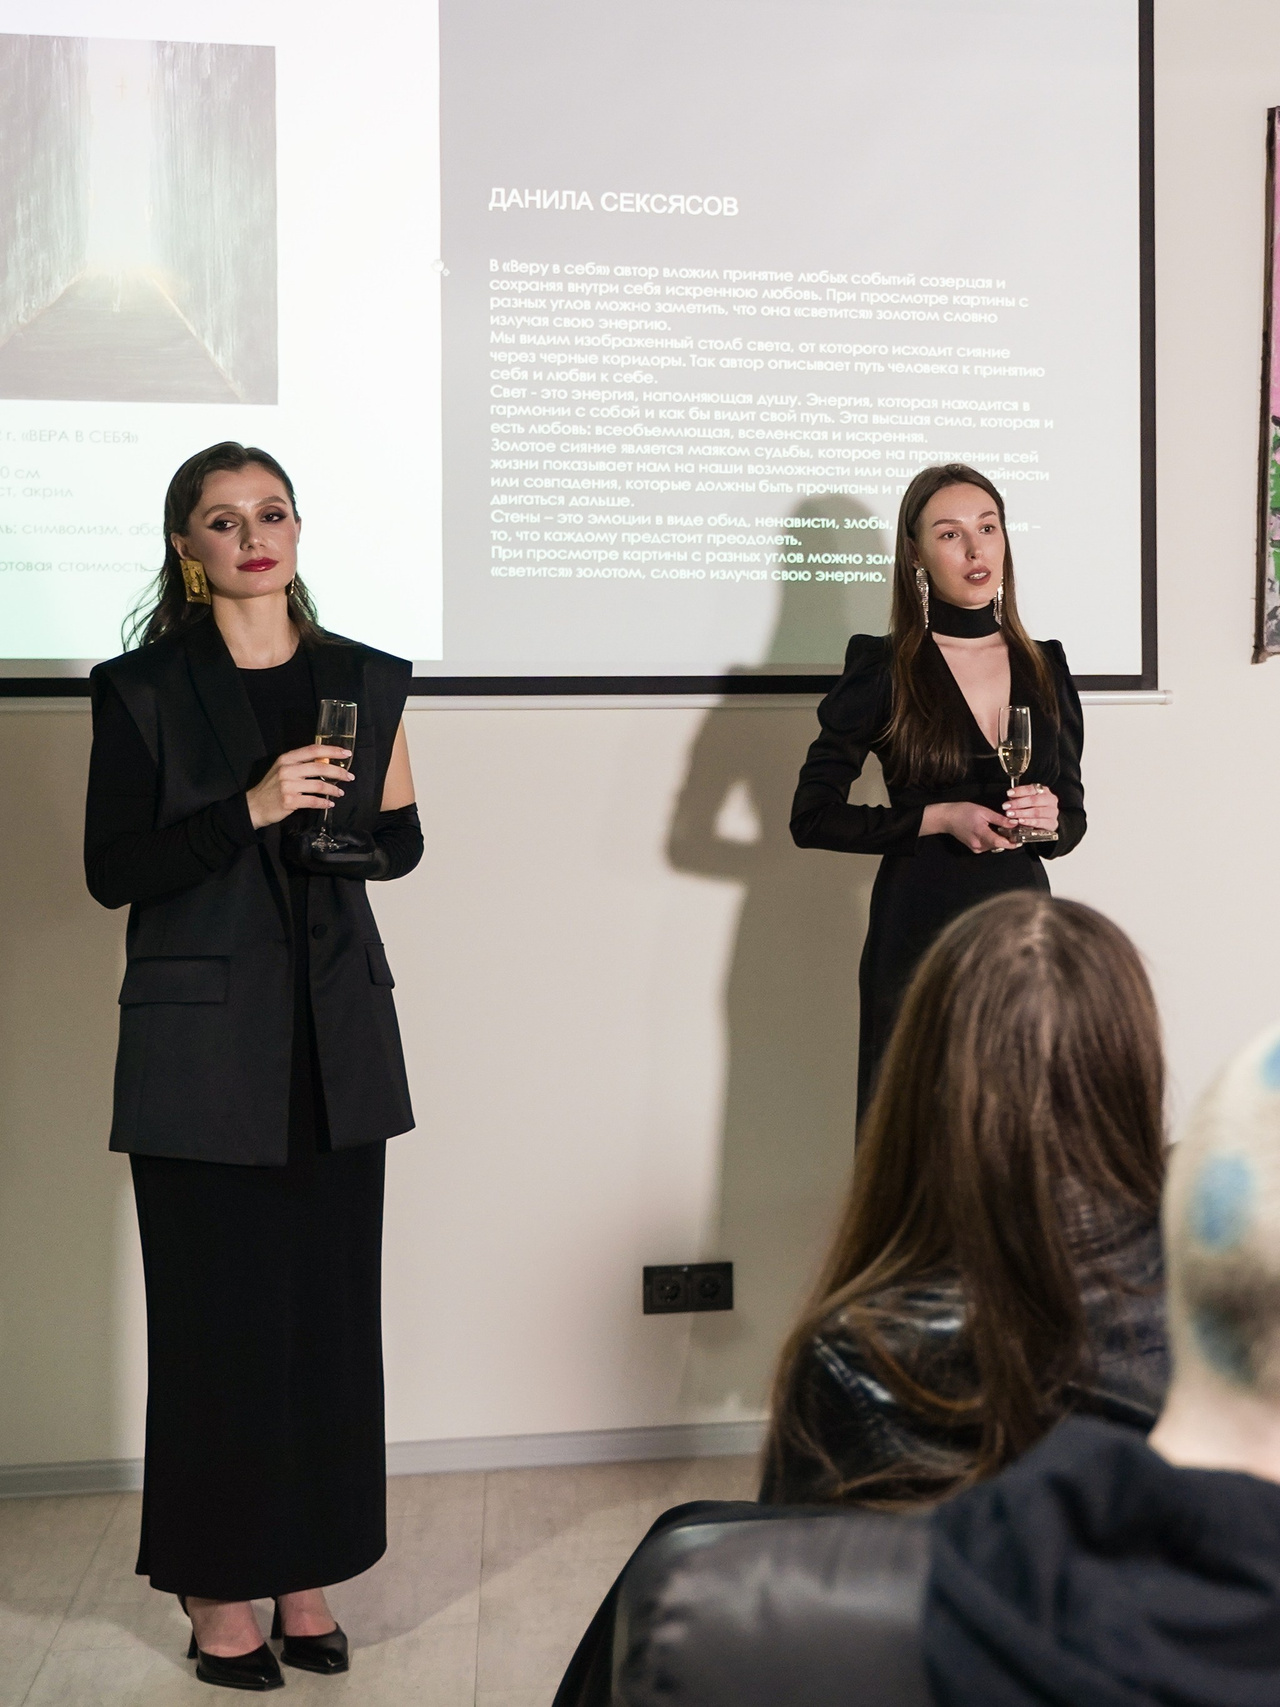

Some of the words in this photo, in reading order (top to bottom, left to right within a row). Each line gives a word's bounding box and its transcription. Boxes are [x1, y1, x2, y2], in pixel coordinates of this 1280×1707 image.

[488, 187, 594, 212] ДАНИЛА
[600, 191, 739, 216] СЕКСЯСОВ
[489, 258, 499, 272] В
[501, 259, 550, 277] «Веру
[552, 263, 561, 274] в
[563, 261, 610, 276] себя»
[613, 265, 659, 280] автор
[662, 267, 720, 279] вложил
[722, 269, 794, 283] принятие
[797, 269, 848, 284] любых
[850, 271, 916, 286] событий
[919, 276, 993, 291] созерцая
[995, 278, 1006, 289] и
[488, 279, 563, 294] сохраняя
[567, 281, 619, 296] внутри
[622, 281, 661, 295] себя
[665, 285, 758, 299] искреннюю
[761, 286, 822, 301] любовь.
[826, 287, 856, 304] При
[860, 291, 949, 307] просмотре
[952, 294, 1016, 308] картины
[1018, 296, 1029, 308] с
[489, 296, 547, 310] разных
[549, 298, 591, 312] углов
[594, 300, 651, 313] можно
[654, 301, 729, 316] заметить,
[732, 304, 757, 316] что
[760, 305, 791, 317] она
[793, 306, 873, 319] «светится»
[875, 309, 940, 321] золотом
[942, 311, 998, 324] словно
[489, 314, 549, 329] излучая
[552, 316, 595, 329] свою
[598, 318, 672, 333] энергию.
[489, 330, 515, 344] Мы
[519, 333, 571, 346] видим
[574, 333, 694, 350] изображенный
[697, 337, 743, 351] столб
[746, 340, 794, 353] света,
[798, 341, 816, 353] от
[818, 342, 889, 357] которого
[891, 344, 953, 357] исходит
[956, 346, 1011, 359] сияние
[489, 351, 536, 365] через
[539, 352, 599, 366] черные
[602, 354, 686, 369] коридоры.
[689, 353, 716, 368] Так
[718, 356, 765, 372] автор
[767, 358, 851, 372] описывает
[853, 361, 885, 375] путь
[887, 362, 959, 375] человека
[961, 364, 970, 375] к
[973, 364, 1045, 378] принятию
[489, 366, 528, 381] себя
[532, 370, 543, 381] и
[546, 367, 596, 382] любви
[600, 371, 609, 383] к
[612, 369, 658, 384] себе.
[489, 383, 528, 399] Свет
[540, 387, 568, 400] это
[571, 388, 639, 403] энергия,
[642, 391, 753, 405] наполняющая
[756, 394, 802, 408] душу.
[805, 392, 873, 409] Энергия,
[877, 397, 938, 411] которая
[941, 399, 1019, 412] находится
[1022, 400, 1030, 412] в
[489, 404, 571, 419] гармонии
[574, 406, 586, 418] с
[589, 404, 640, 419] собой
[644, 408, 655, 419] и
[658, 408, 685, 420] как
[688, 406, 710, 420] бы
[713, 410, 757, 422] видит
[759, 408, 797, 422] свой
[799, 412, 835, 426] путь.
[839, 409, 868, 424] Эта
[872, 413, 931, 426] высшая
[933, 415, 976, 428] сила,
[980, 417, 1040, 431] которая
[1044, 418, 1054, 429] и
[21, 429, 70, 443] «ВЕРА
[74, 429, 85, 443] В
[88, 430, 140, 444] СЕБЯ»
[490, 422, 525, 434] есть
[528, 420, 591, 436] любовь:
[594, 422, 734, 440] всеобъемлющая,
[737, 428, 828, 441] вселенская
[831, 430, 842, 441] и
[845, 431, 928, 445] искренняя.
[490, 437, 556, 453] Золотое
[559, 441, 617, 454] сияние
[620, 443, 684, 455] является
[687, 445, 751, 457] маяком
[753, 444, 814, 460] судьбы,
[817, 447, 882, 462] которое
[885, 449, 905, 460] на
[908, 449, 1000, 466] протяжении
[1003, 450, 1039, 463] всей
[14, 468, 41, 480] см
[489, 458, 539, 470] жизни
[542, 459, 634, 472] показывает
[636, 461, 671, 473] нам
[674, 462, 695, 473] на
[698, 462, 743, 474] наши
[747, 463, 851, 477] возможности
[854, 466, 882, 477] или
[981, 467, 1050, 481] айности
[22, 487, 74, 500] акрил
[490, 476, 519, 488] или
[522, 476, 622, 491] совпадения,
[625, 479, 692, 493] которые
[694, 480, 756, 492] должны
[758, 478, 793, 493] быть
[796, 482, 878, 497] прочитаны
[881, 484, 892, 495] и
[489, 493, 565, 506] двигаться
[568, 495, 635, 507] дальше.
[490, 508, 541, 523] Стены
[556, 512, 584, 524] это
[587, 513, 651, 526] эмоции
[655, 514, 663, 526] в
[666, 515, 704, 527] виде
[706, 512, 751, 528] обид,
[754, 516, 840, 530] ненависти,
[843, 516, 893, 530] злобы,
[489, 529, 512, 542] то,
[515, 530, 541, 542] что
[543, 530, 618, 546] каждому
[621, 531, 703, 546] предстоит
[706, 533, 802, 547] преодолеть.
[491, 544, 523, 562] При
[526, 548, 619, 563] просмотре
[622, 549, 688, 564] картины
[690, 550, 701, 562] с
[705, 550, 761, 565] разных
[763, 551, 804, 566] углов
[806, 552, 863, 565] можно
[58, 561, 146, 573] стоимость
[490, 565, 573, 578] «светится»
[575, 566, 646, 580] золотом,
[650, 567, 706, 580] словно
[709, 569, 767, 583] излучая
[770, 569, 812, 582] свою
[815, 570, 886, 585] энергию.
